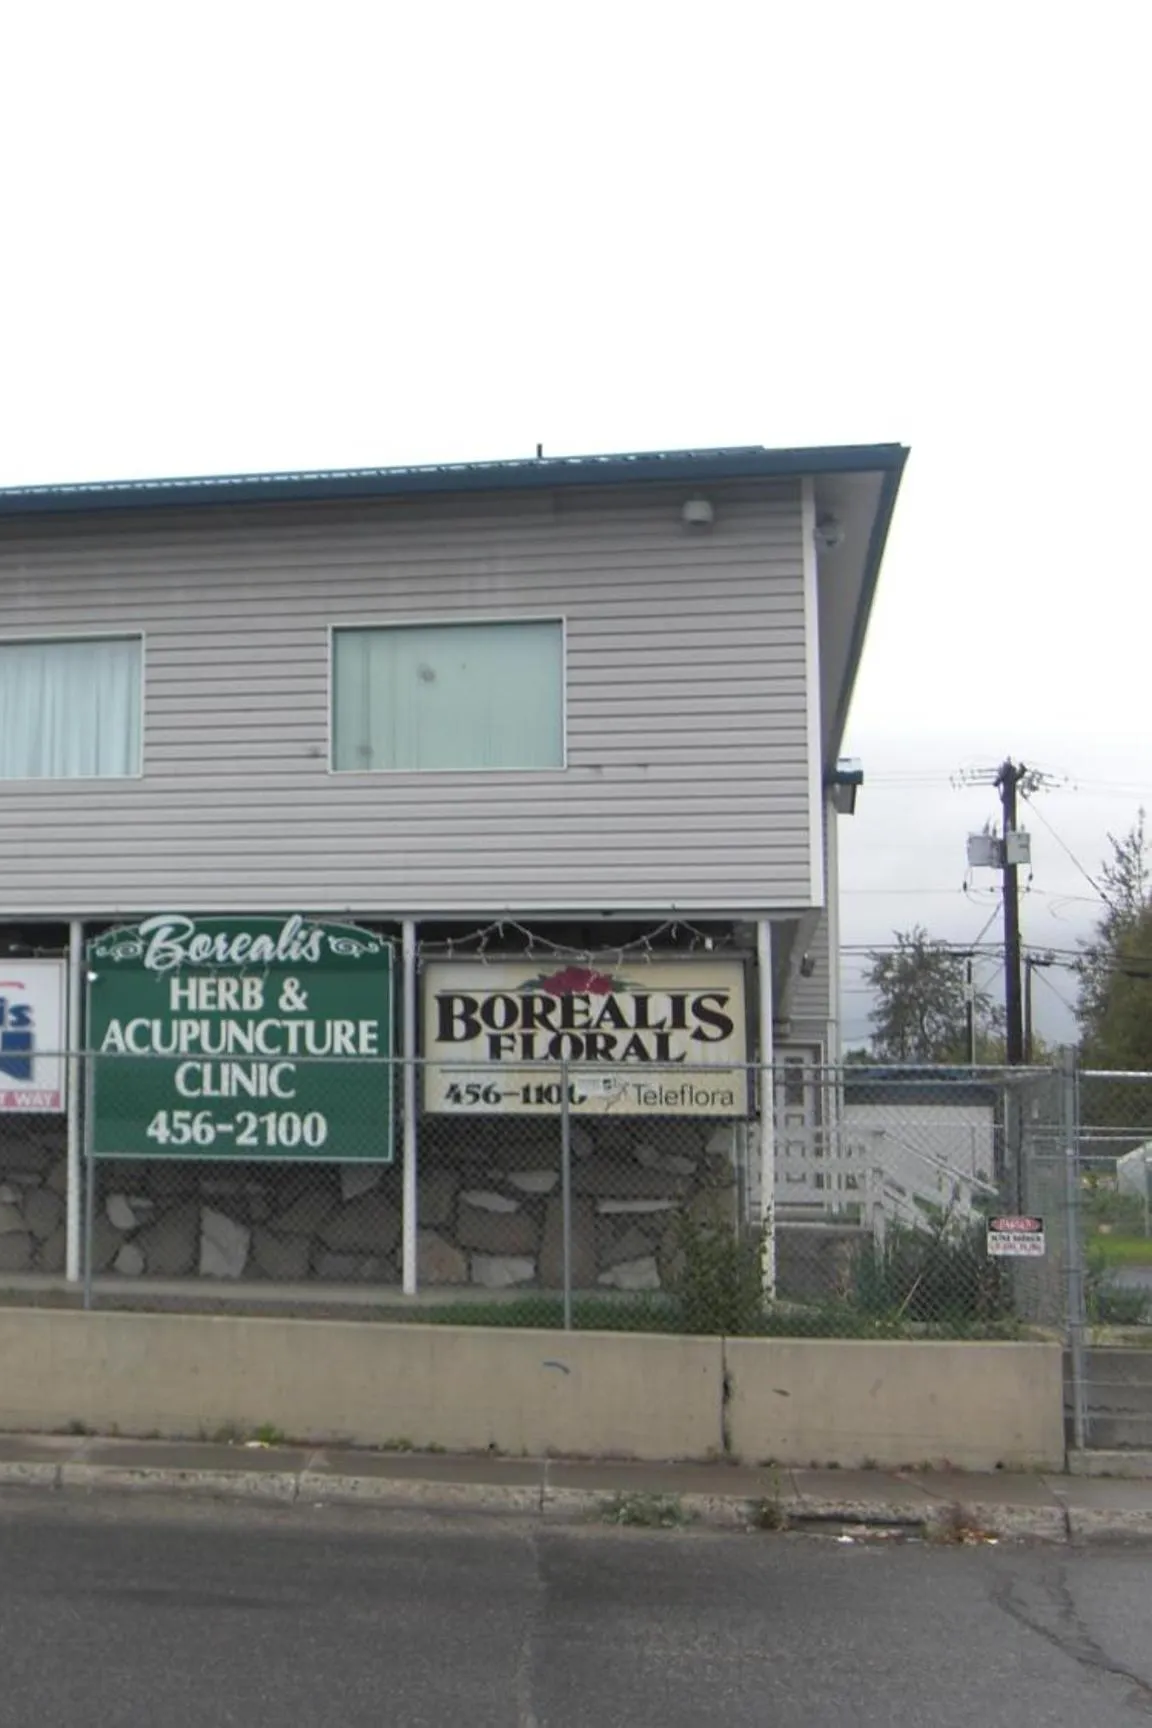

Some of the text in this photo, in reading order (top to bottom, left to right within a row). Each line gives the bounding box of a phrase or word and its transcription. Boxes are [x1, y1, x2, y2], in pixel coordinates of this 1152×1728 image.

[139, 914, 324, 971] Borealis
[169, 976, 309, 1013] HERB &
[99, 1018, 379, 1056] ACUPUNCTURE
[433, 994, 735, 1043] BOREALIS
[487, 1030, 688, 1064] FLORAL
[174, 1061, 297, 1099] CLINIC
[631, 1081, 735, 1107] Teleflora
[14, 1090, 54, 1109] WAY
[146, 1110, 328, 1148] 456-2100
